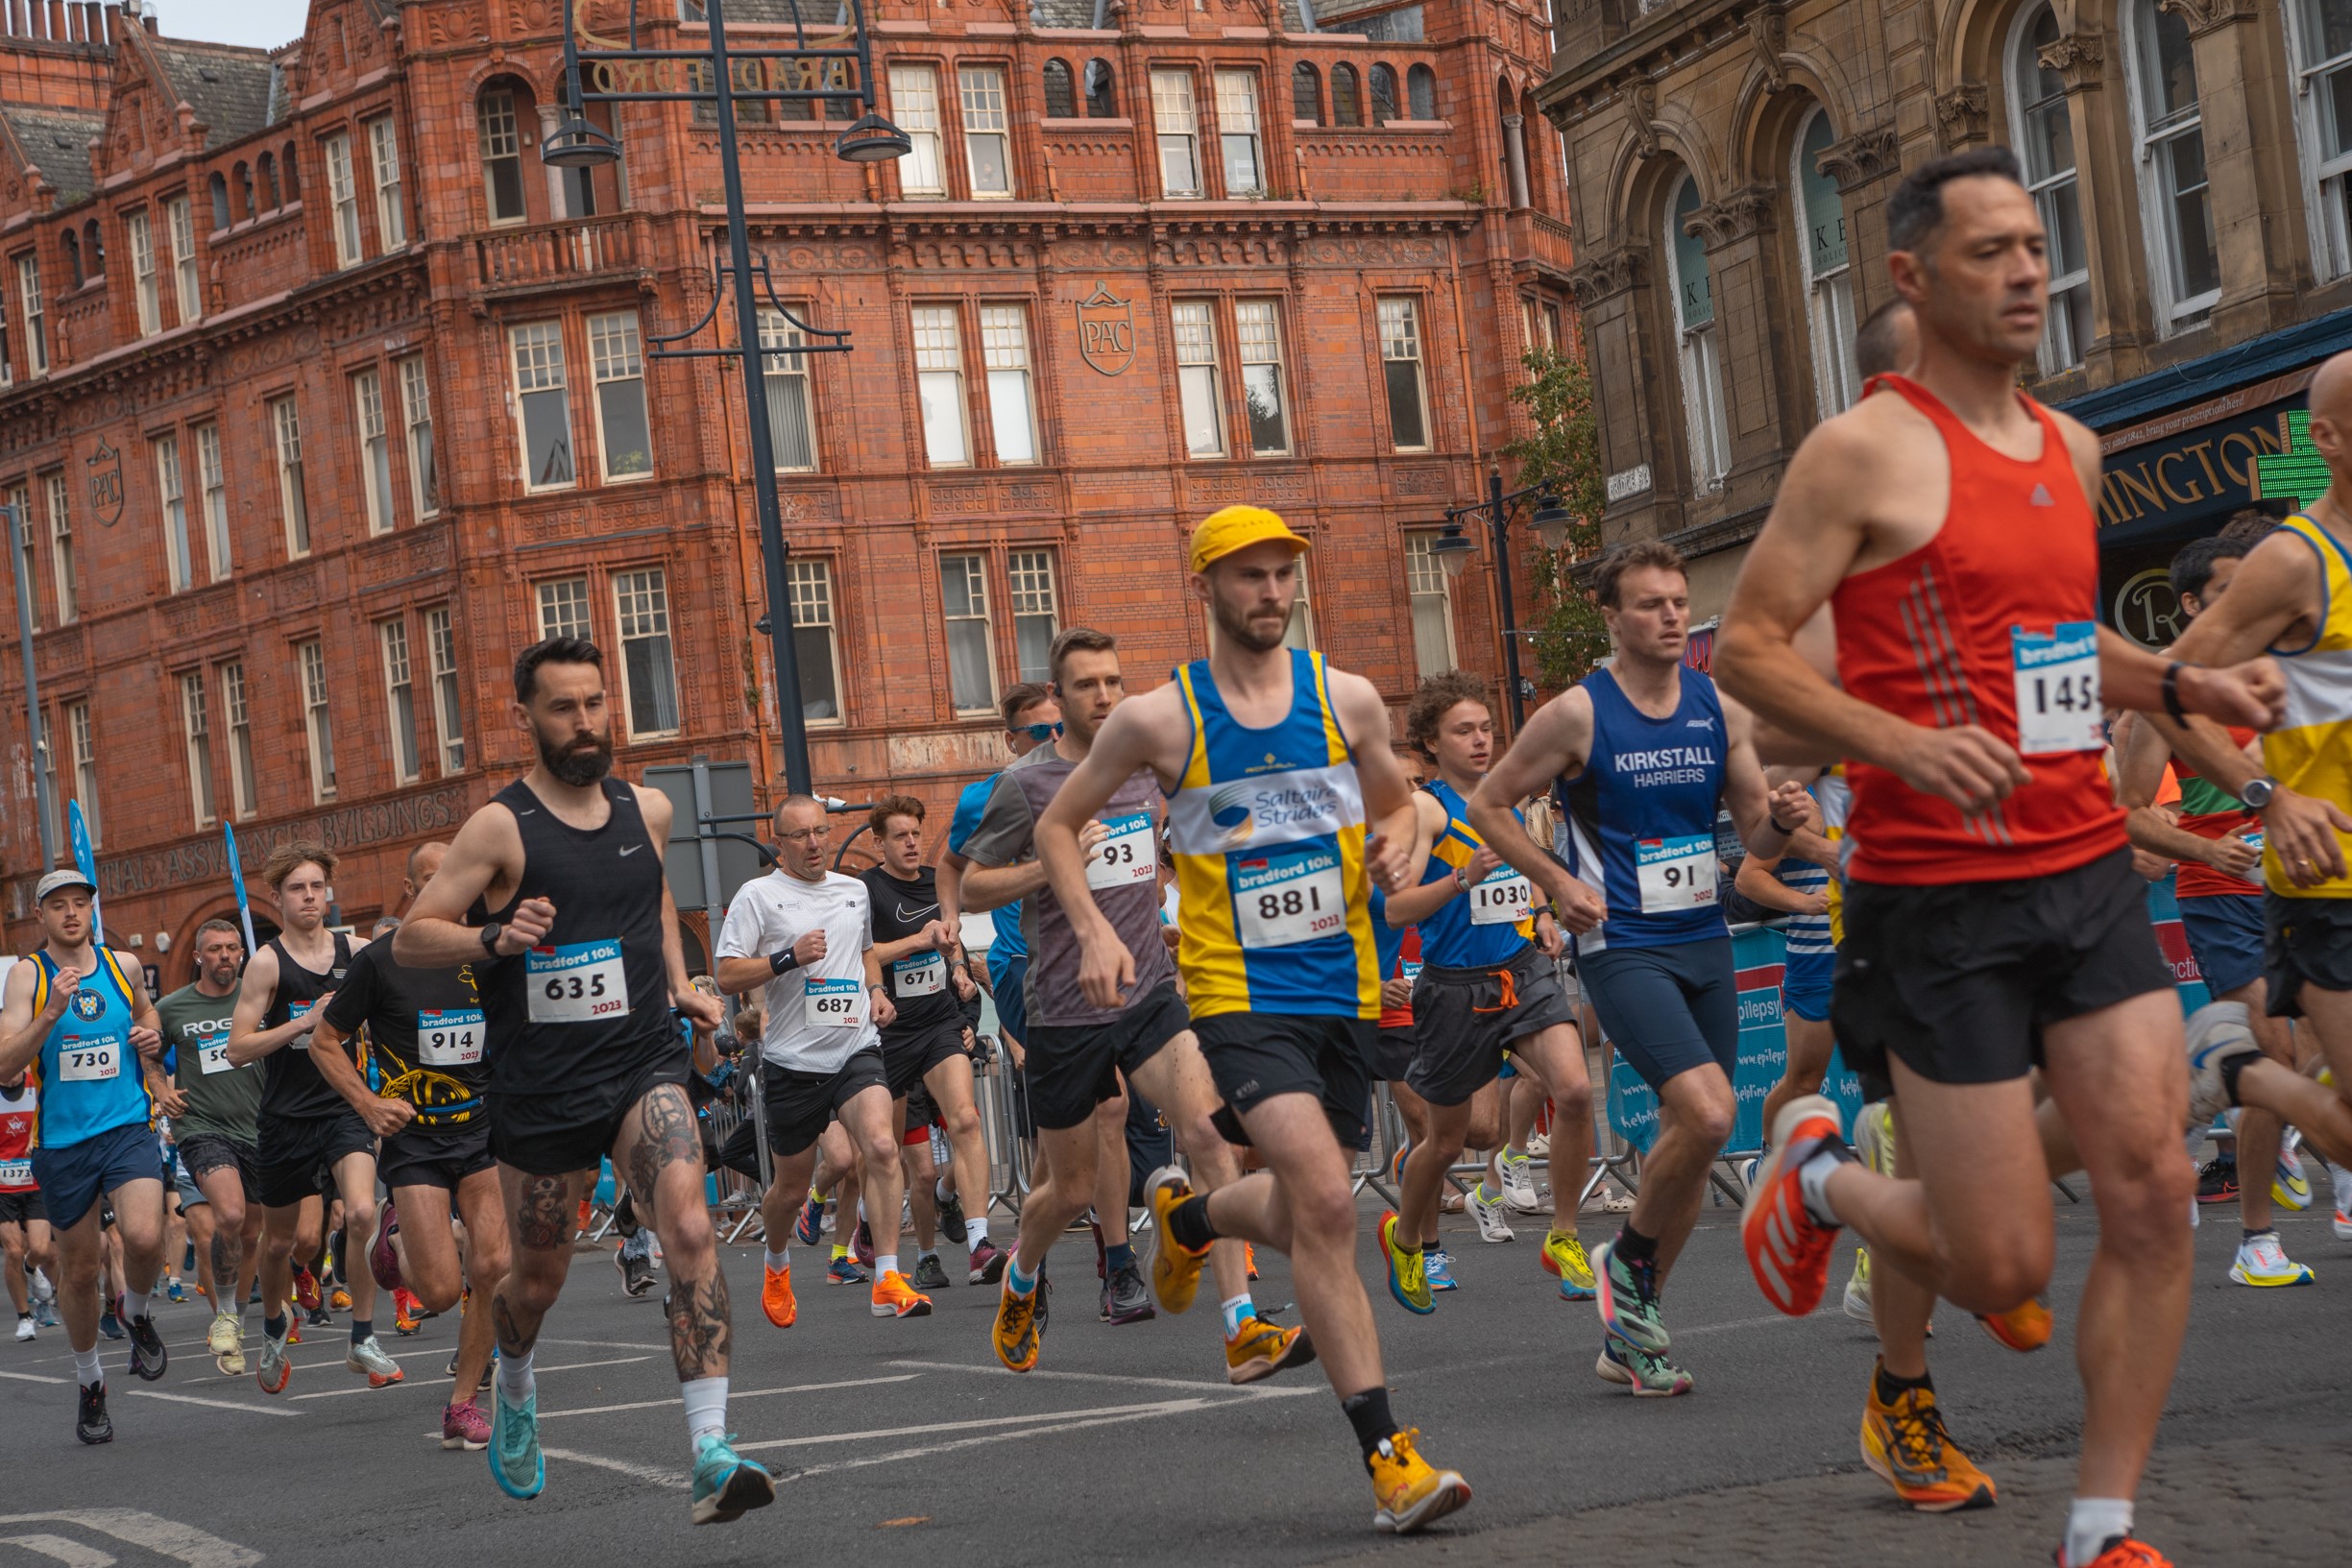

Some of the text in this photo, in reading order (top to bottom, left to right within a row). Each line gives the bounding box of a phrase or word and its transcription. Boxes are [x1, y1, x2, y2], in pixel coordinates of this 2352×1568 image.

[1083, 321, 1130, 353] PAC
[2146, 422, 2165, 436] bring
[2165, 419, 2181, 434] your
[2182, 404, 2226, 428] prescriptions
[2226, 394, 2244, 411] here!
[2034, 675, 2100, 713] 145
[1614, 746, 1715, 773] KIRKSTALL
[1634, 767, 1706, 788] HARRIERS
[1255, 785, 1337, 810] Saltaire
[1258, 801, 1337, 828] Striders
[1128, 818, 1148, 831] 10k
[167, 821, 302, 884] ASSVANCE
[1103, 843, 1133, 866] 93
[1639, 843, 1693, 862] bradford
[1131, 864, 1152, 878] 2023
[1238, 855, 1334, 888] bradford 10k
[1664, 865, 1694, 888] 91
[1258, 885, 1321, 920] 881
[1480, 884, 1527, 907] 1030
[1693, 889, 1712, 903] 2023
[1310, 914, 1341, 932] 2023
[530, 946, 616, 970] bradford 10k
[895, 959, 928, 970] bradford
[546, 973, 605, 1001] 635
[905, 970, 934, 985] 671
[808, 984, 845, 994] bradford
[592, 1000, 622, 1015] 2023
[816, 998, 853, 1013] 687
[182, 1018, 234, 1038] ROG
[423, 1014, 482, 1027] bradford 10k
[61, 1035, 116, 1050] bradford 10k
[431, 1031, 473, 1049] 914
[72, 1051, 109, 1068] 730
[461, 1051, 479, 1060] 2023
[100, 1068, 117, 1076] 2023
[3, 1169, 30, 1178] 1373
